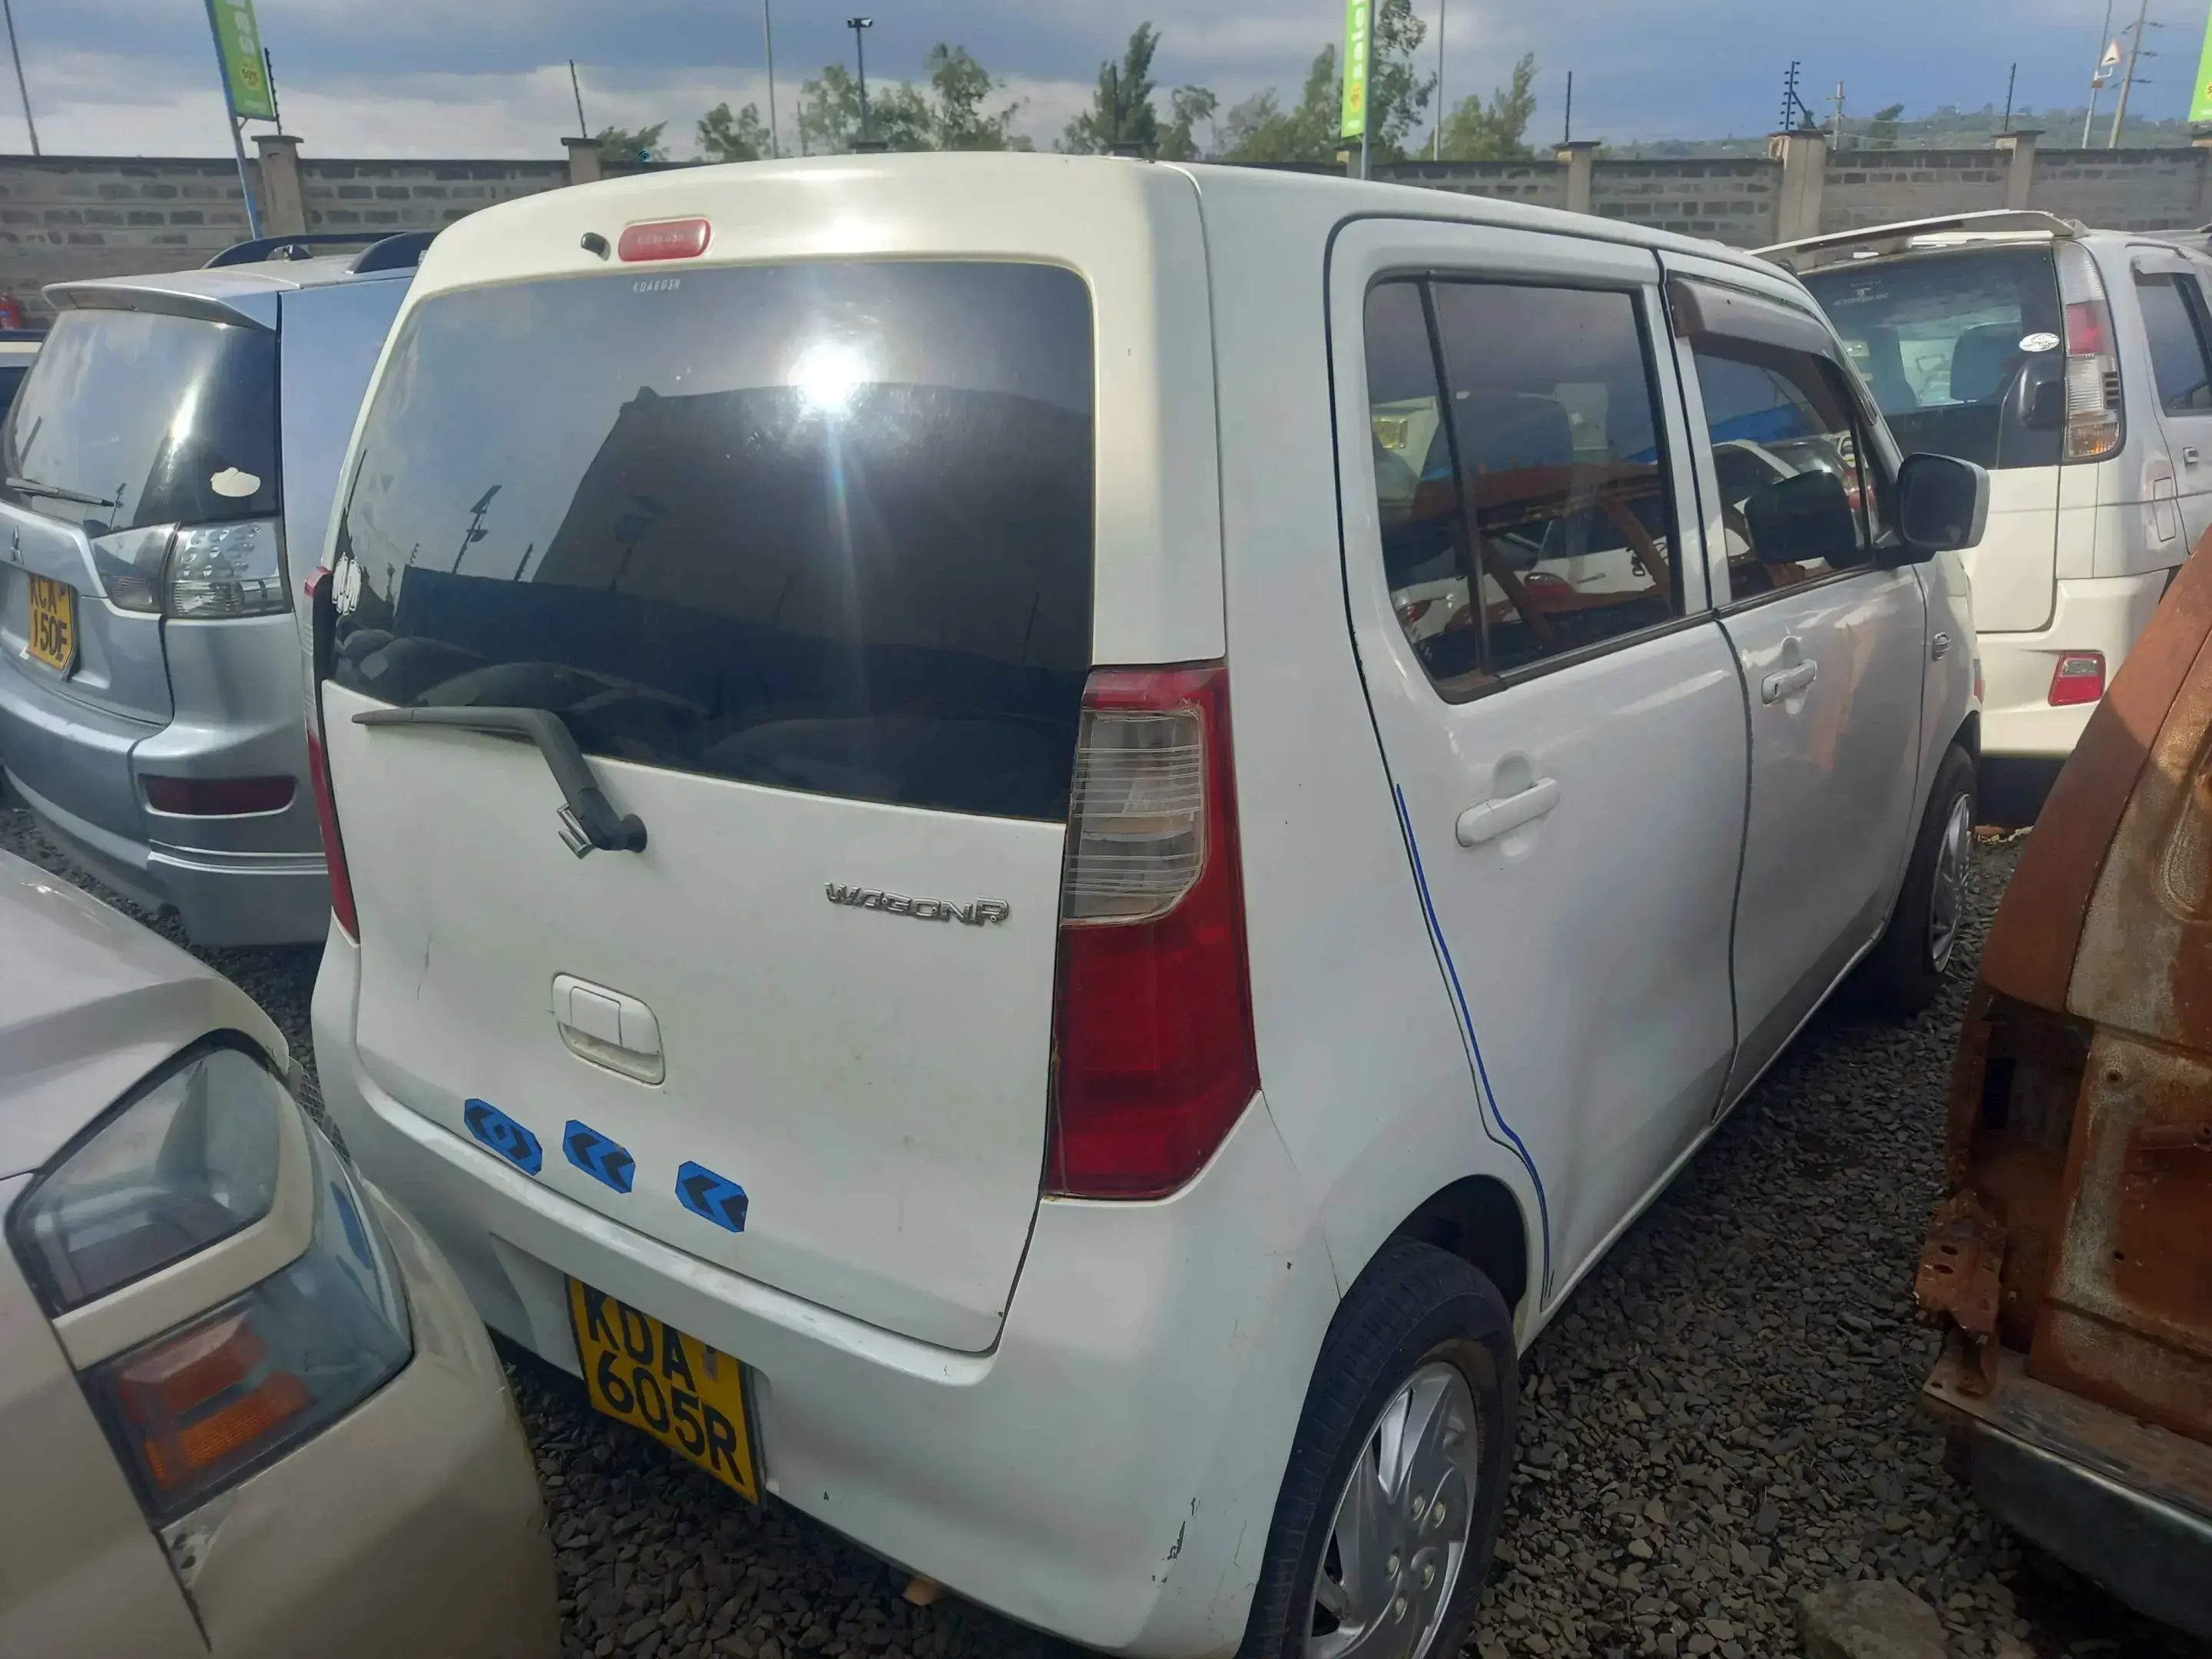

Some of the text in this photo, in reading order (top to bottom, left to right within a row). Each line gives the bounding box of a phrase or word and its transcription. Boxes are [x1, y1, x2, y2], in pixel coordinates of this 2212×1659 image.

[33, 609, 68, 662] 150E
[581, 1280, 697, 1392] KDA
[598, 1349, 747, 1487] 605R
